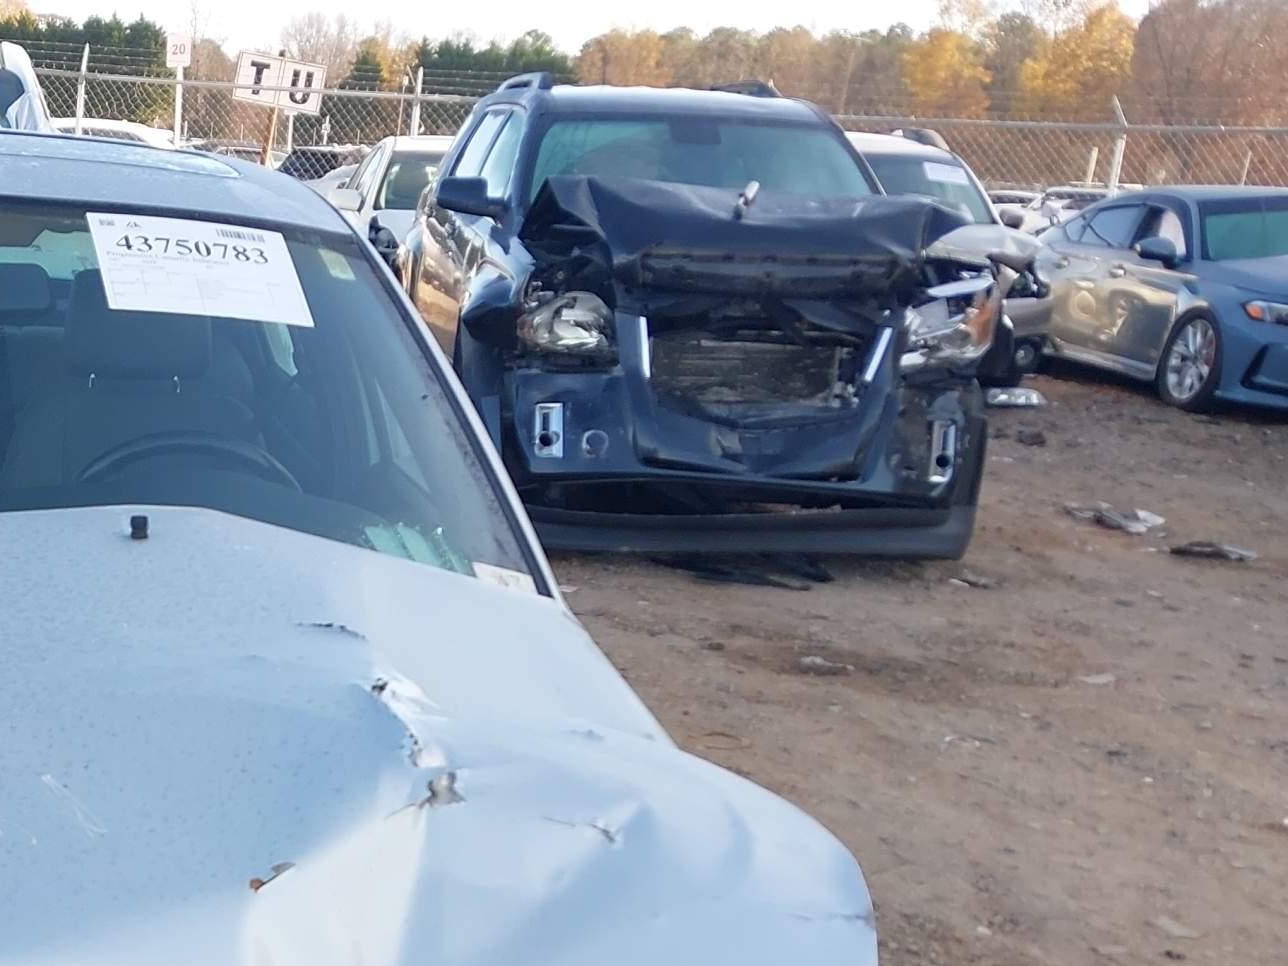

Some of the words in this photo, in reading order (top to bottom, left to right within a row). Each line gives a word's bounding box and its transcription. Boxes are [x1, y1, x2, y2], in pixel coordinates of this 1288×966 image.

[171, 43, 187, 56] 20
[250, 59, 271, 95] T
[288, 69, 315, 105] U
[115, 234, 269, 264] 43750783
